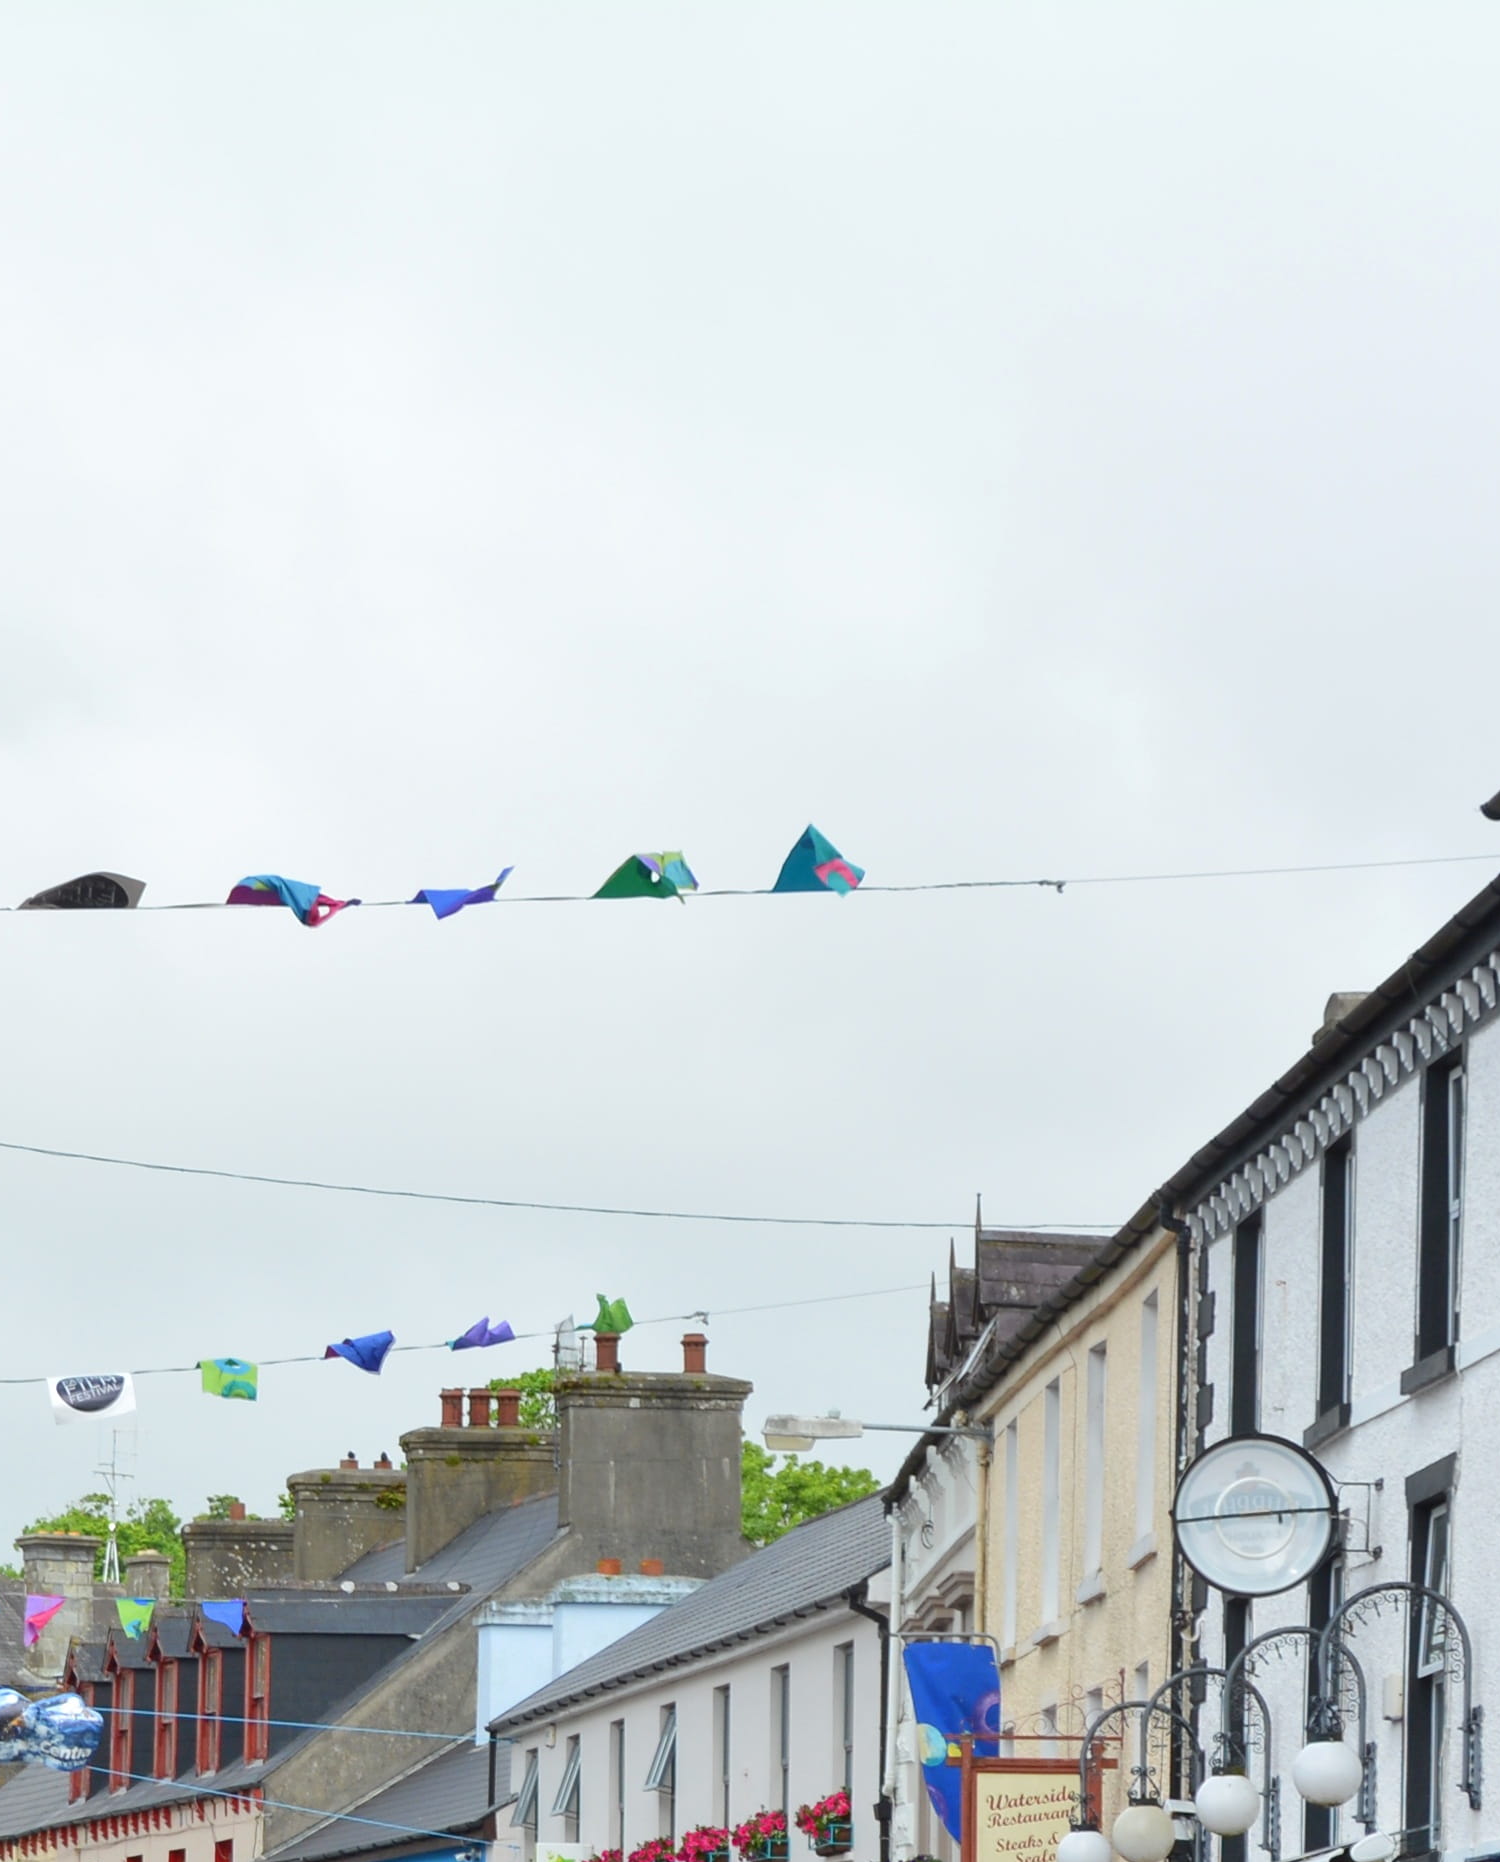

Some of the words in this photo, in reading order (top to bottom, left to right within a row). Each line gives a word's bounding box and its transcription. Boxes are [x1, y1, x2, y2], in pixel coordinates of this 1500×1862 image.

[70, 1383, 121, 1402] FESTIVAL
[41, 1741, 92, 1760] Centra
[996, 1835, 1043, 1853] Steaks
[1048, 1832, 1060, 1845] &
